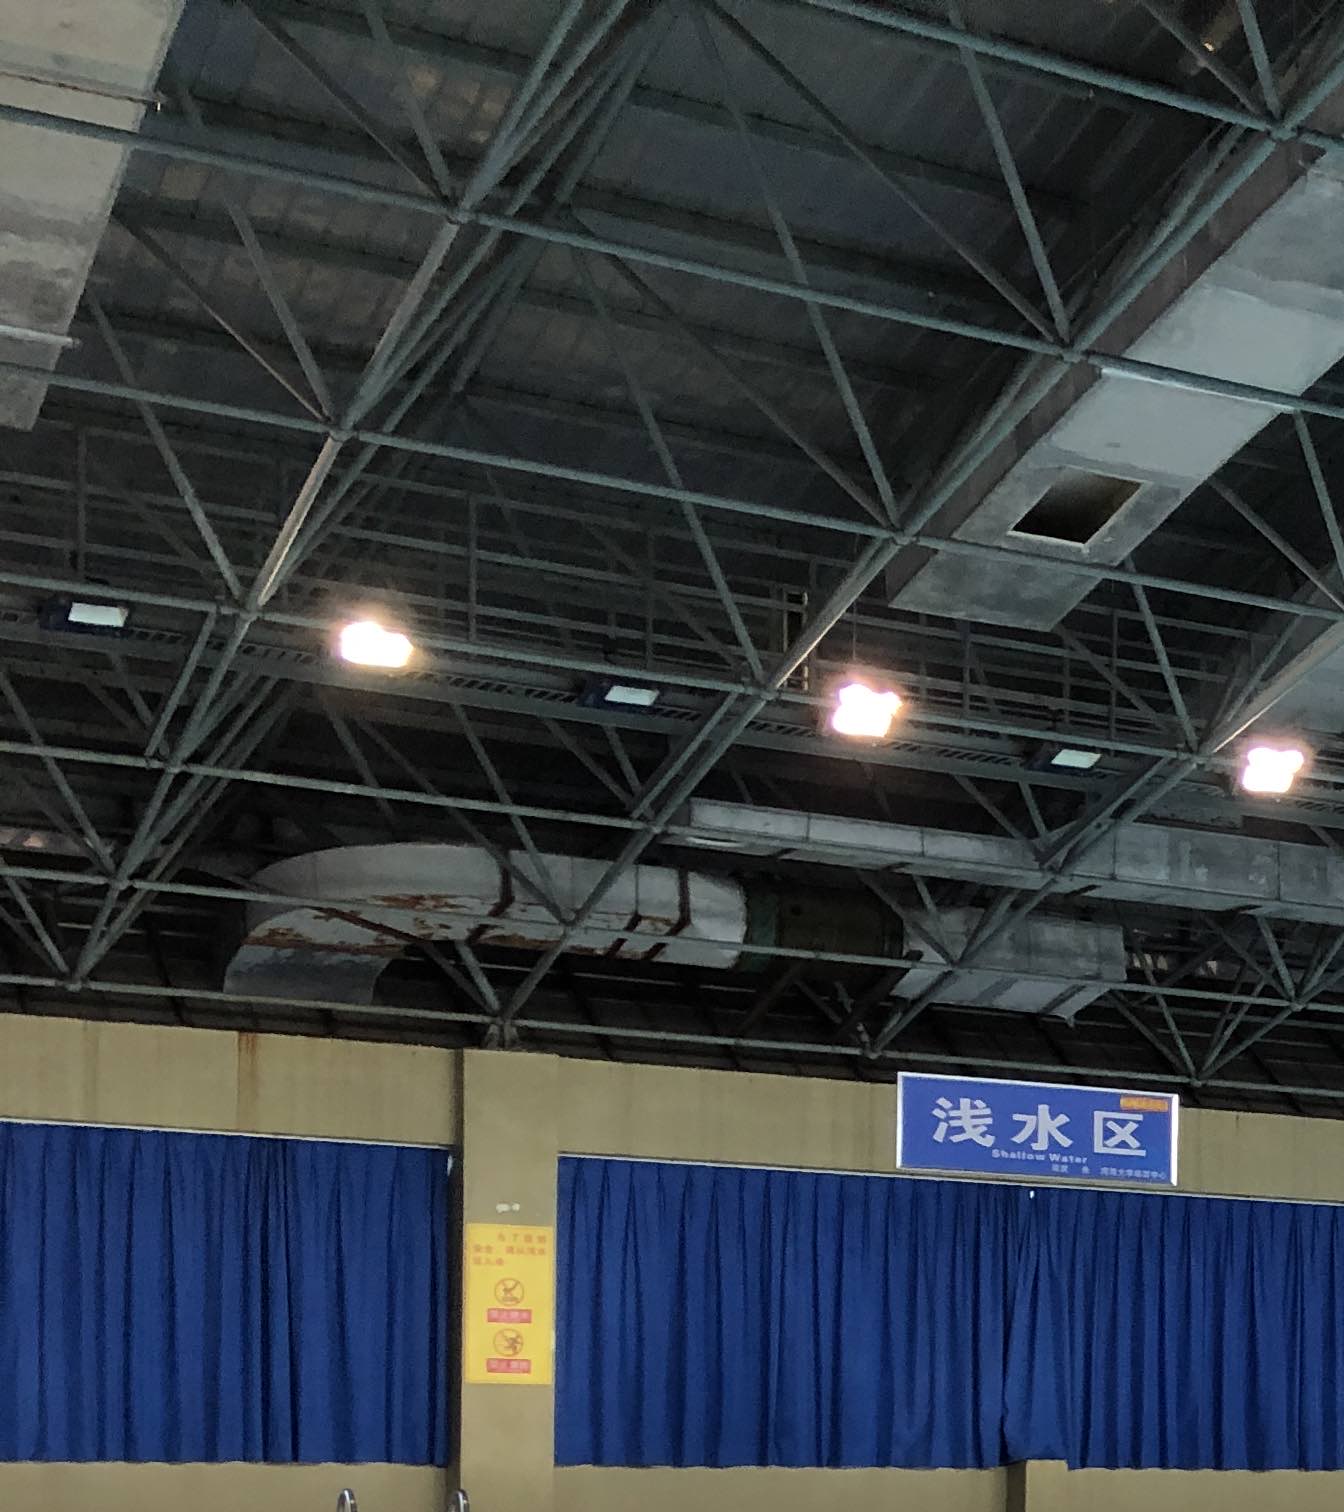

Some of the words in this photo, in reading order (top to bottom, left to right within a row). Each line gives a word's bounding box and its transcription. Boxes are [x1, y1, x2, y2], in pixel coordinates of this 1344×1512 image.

[932, 1097, 1147, 1157] 浅水区
[991, 1149, 1045, 1162] Shallow
[1049, 1153, 1088, 1165] Water
